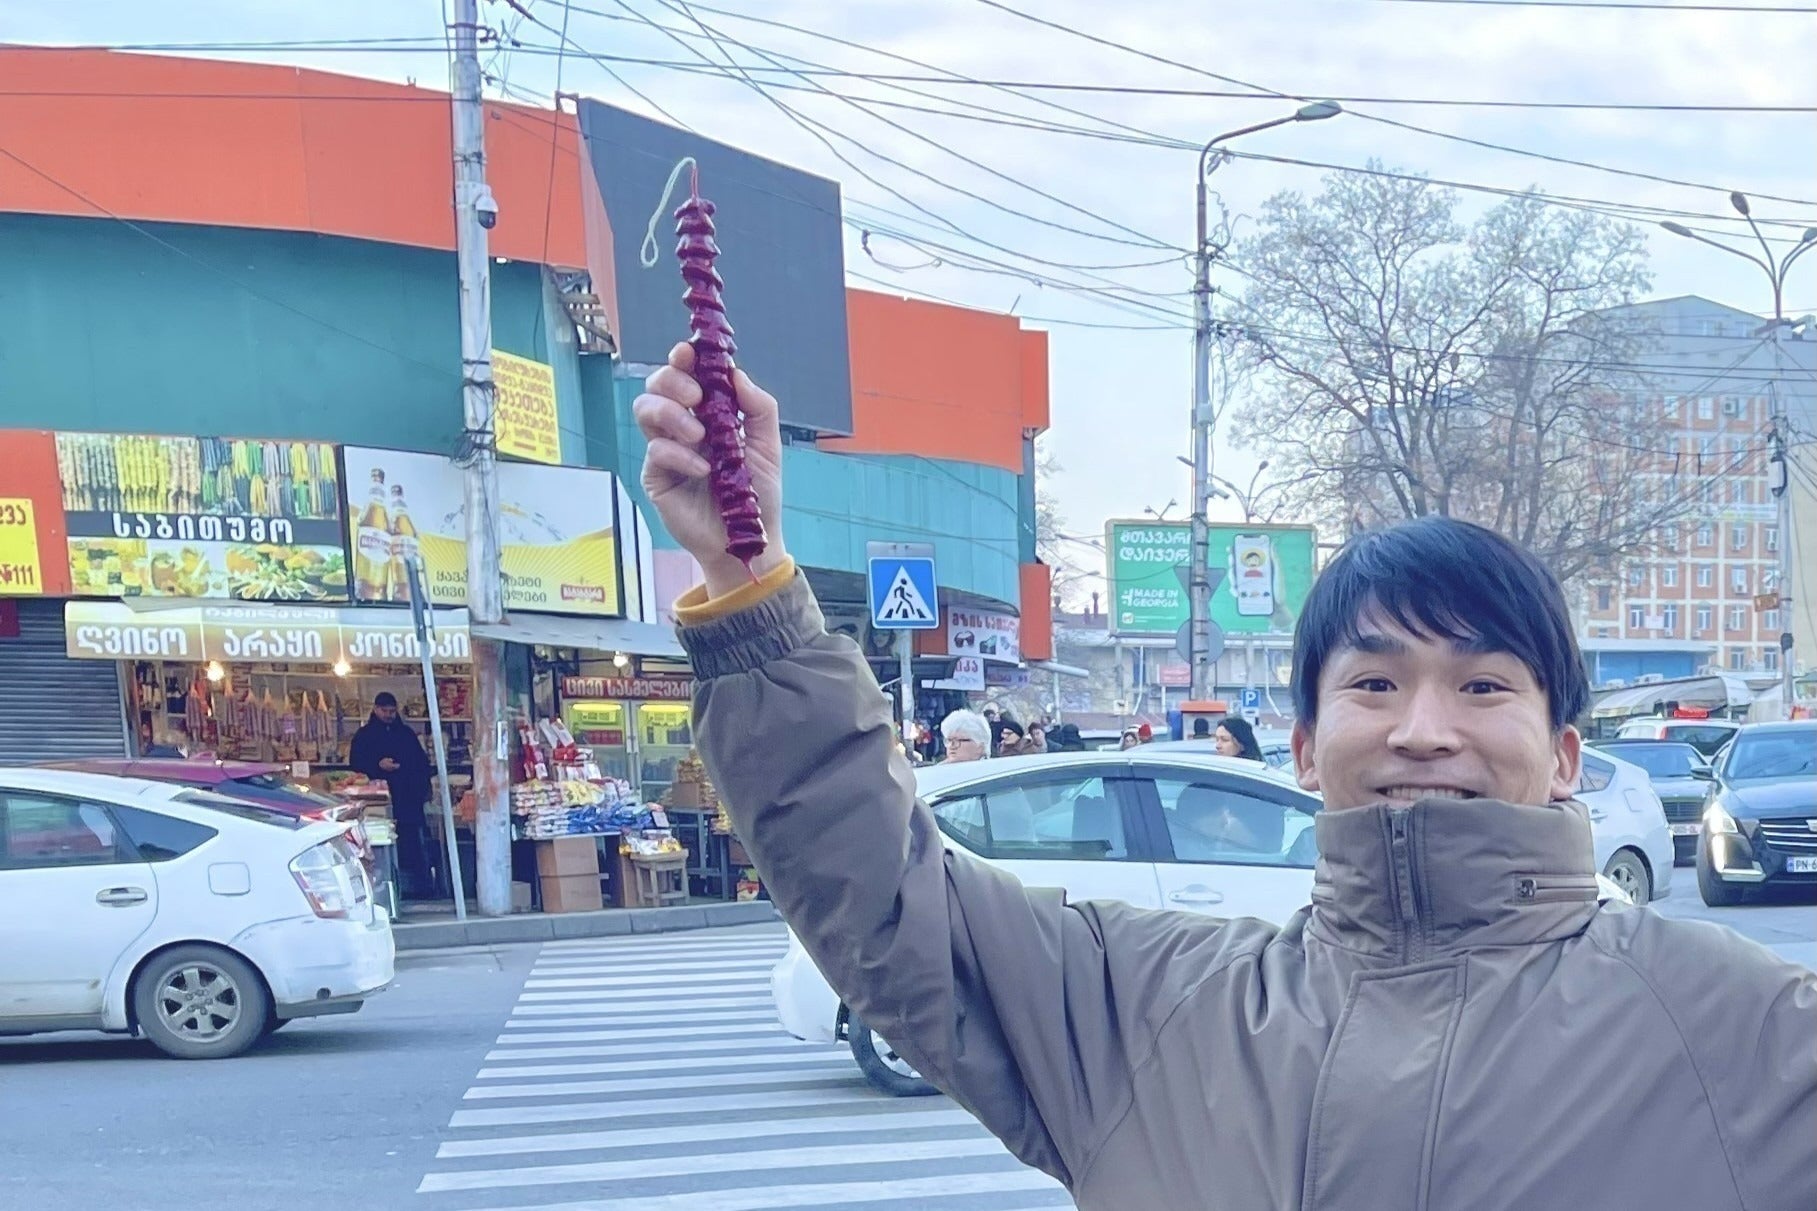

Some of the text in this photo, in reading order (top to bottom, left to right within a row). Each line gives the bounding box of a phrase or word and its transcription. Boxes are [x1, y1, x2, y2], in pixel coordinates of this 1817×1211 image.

[112, 513, 293, 544] საბითუმო
[432, 585, 466, 598] ცივი
[1134, 589, 1179, 598] MADE IN
[1133, 599, 1179, 608] GEORGIA
[77, 625, 188, 656] ღვინო
[223, 629, 322, 657] არაყი
[565, 677, 690, 698] ცივი სასმელები
[1245, 691, 1256, 706] P
